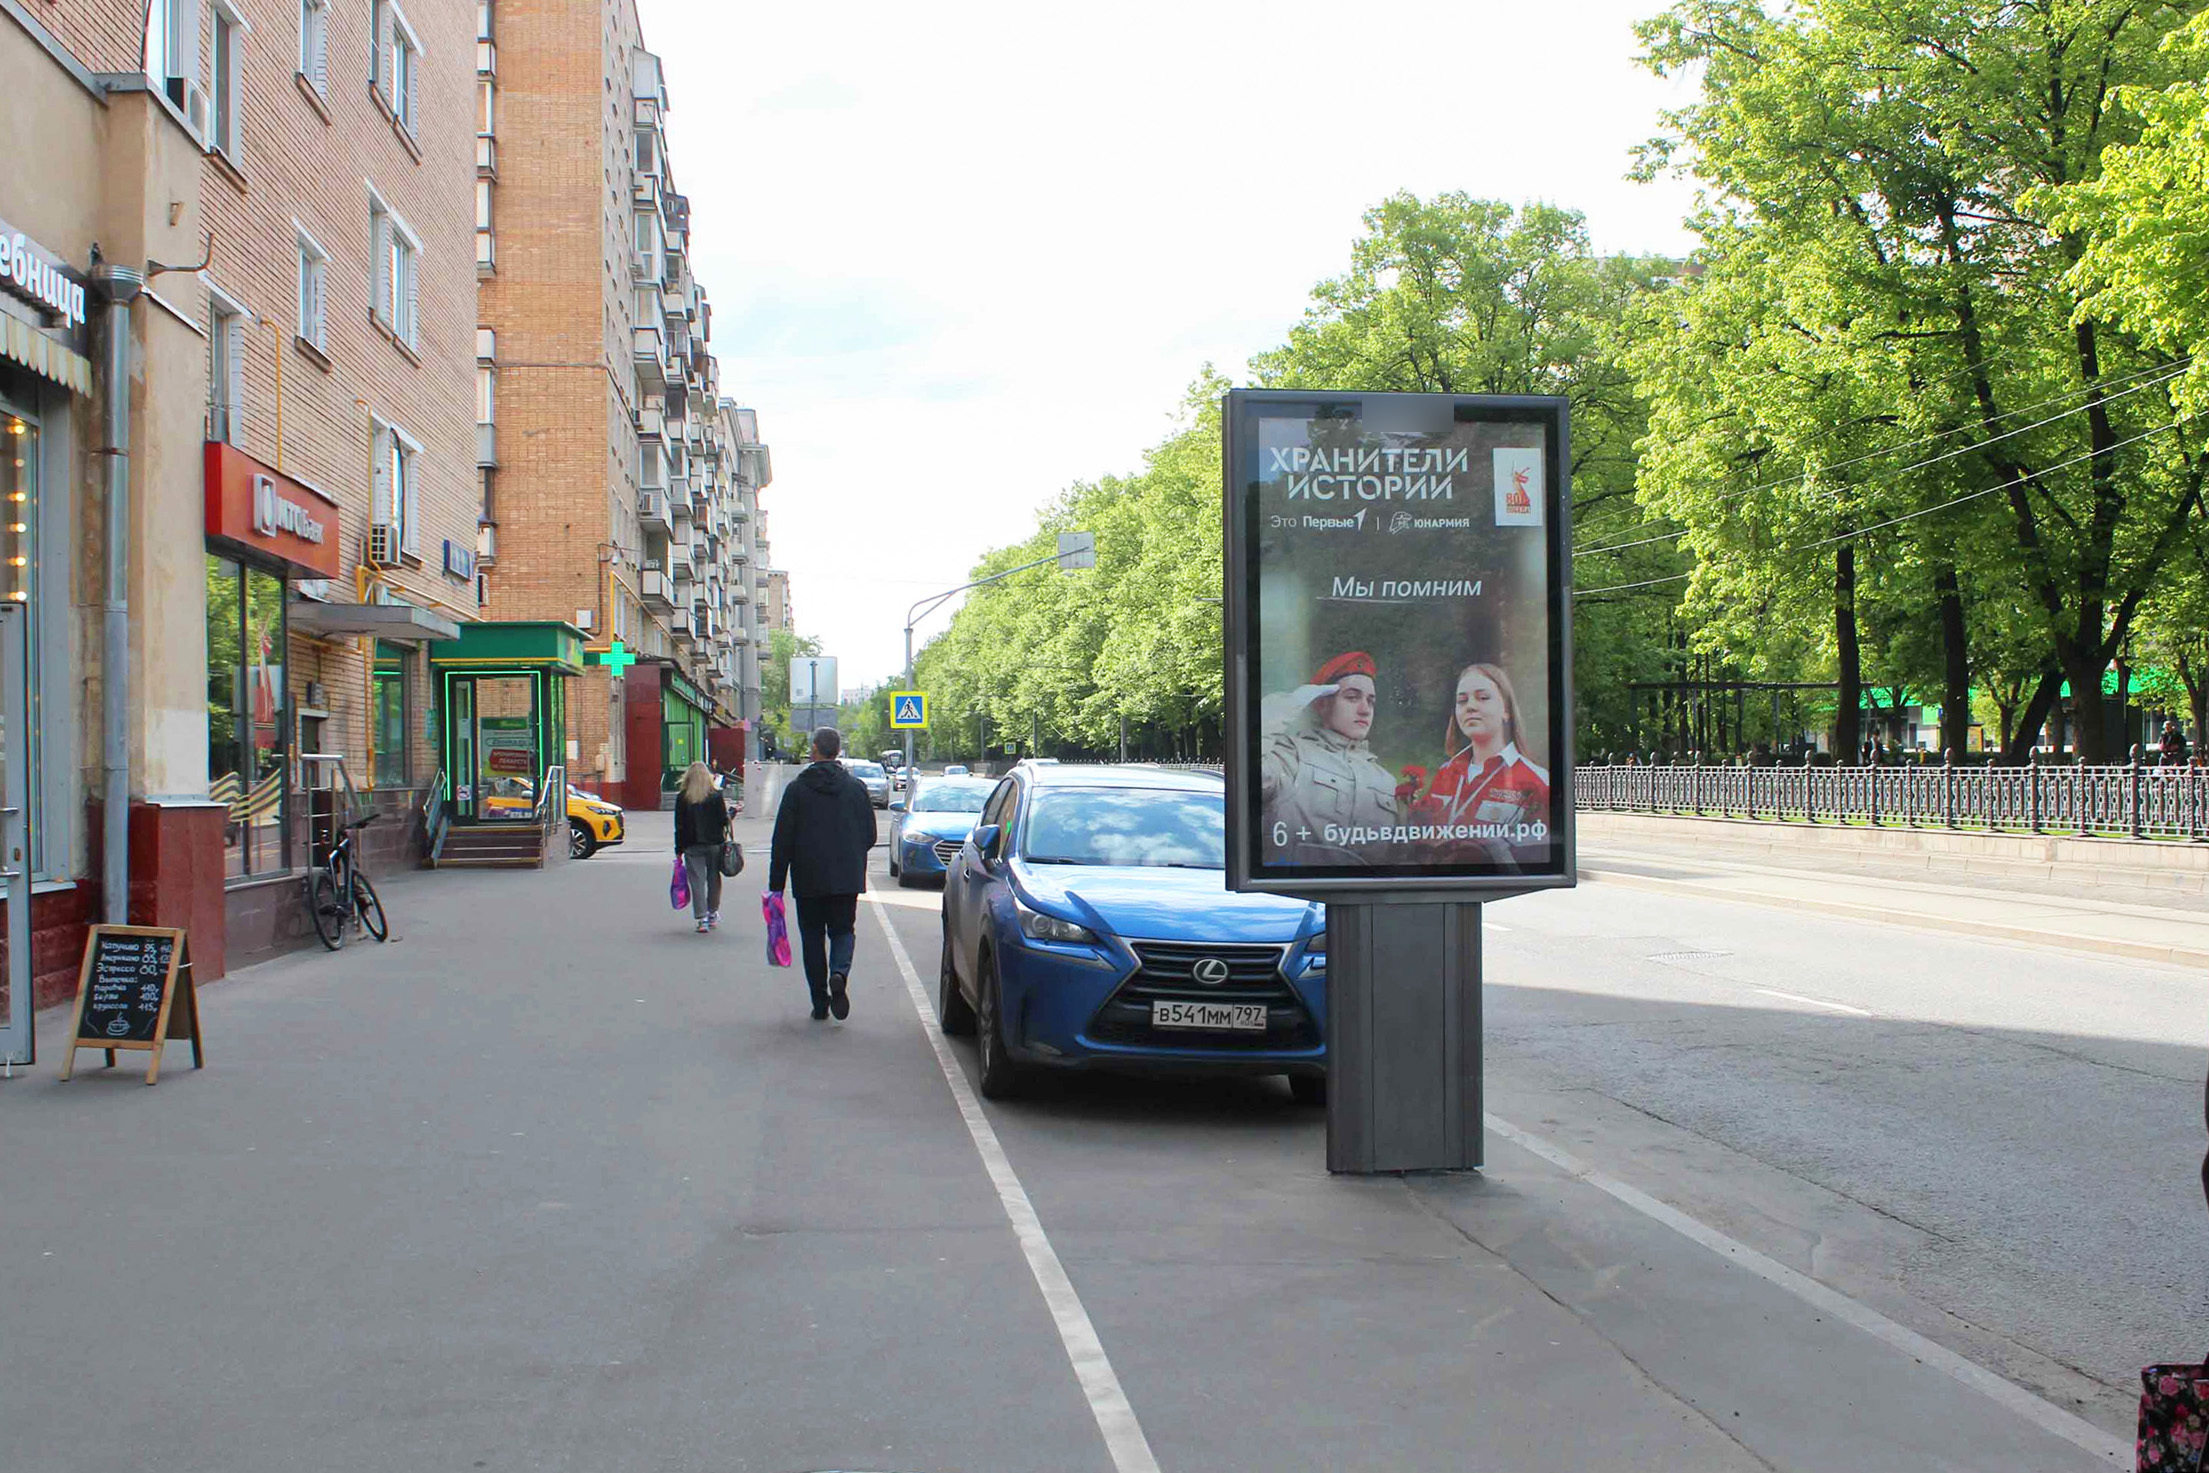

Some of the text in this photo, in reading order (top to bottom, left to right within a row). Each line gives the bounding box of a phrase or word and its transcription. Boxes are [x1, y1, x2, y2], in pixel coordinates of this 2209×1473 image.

[1270, 447, 1468, 473] ХРАНИТЕЛИ
[1288, 474, 1452, 500] ИСТОРИИ
[1270, 515, 1470, 530] Это Первые ЮНАРМИЯ
[1332, 576, 1482, 597] Мы помним
[1324, 819, 1547, 846] будьвдвижении.рф
[1159, 1004, 1261, 1025] В541ММ 797
